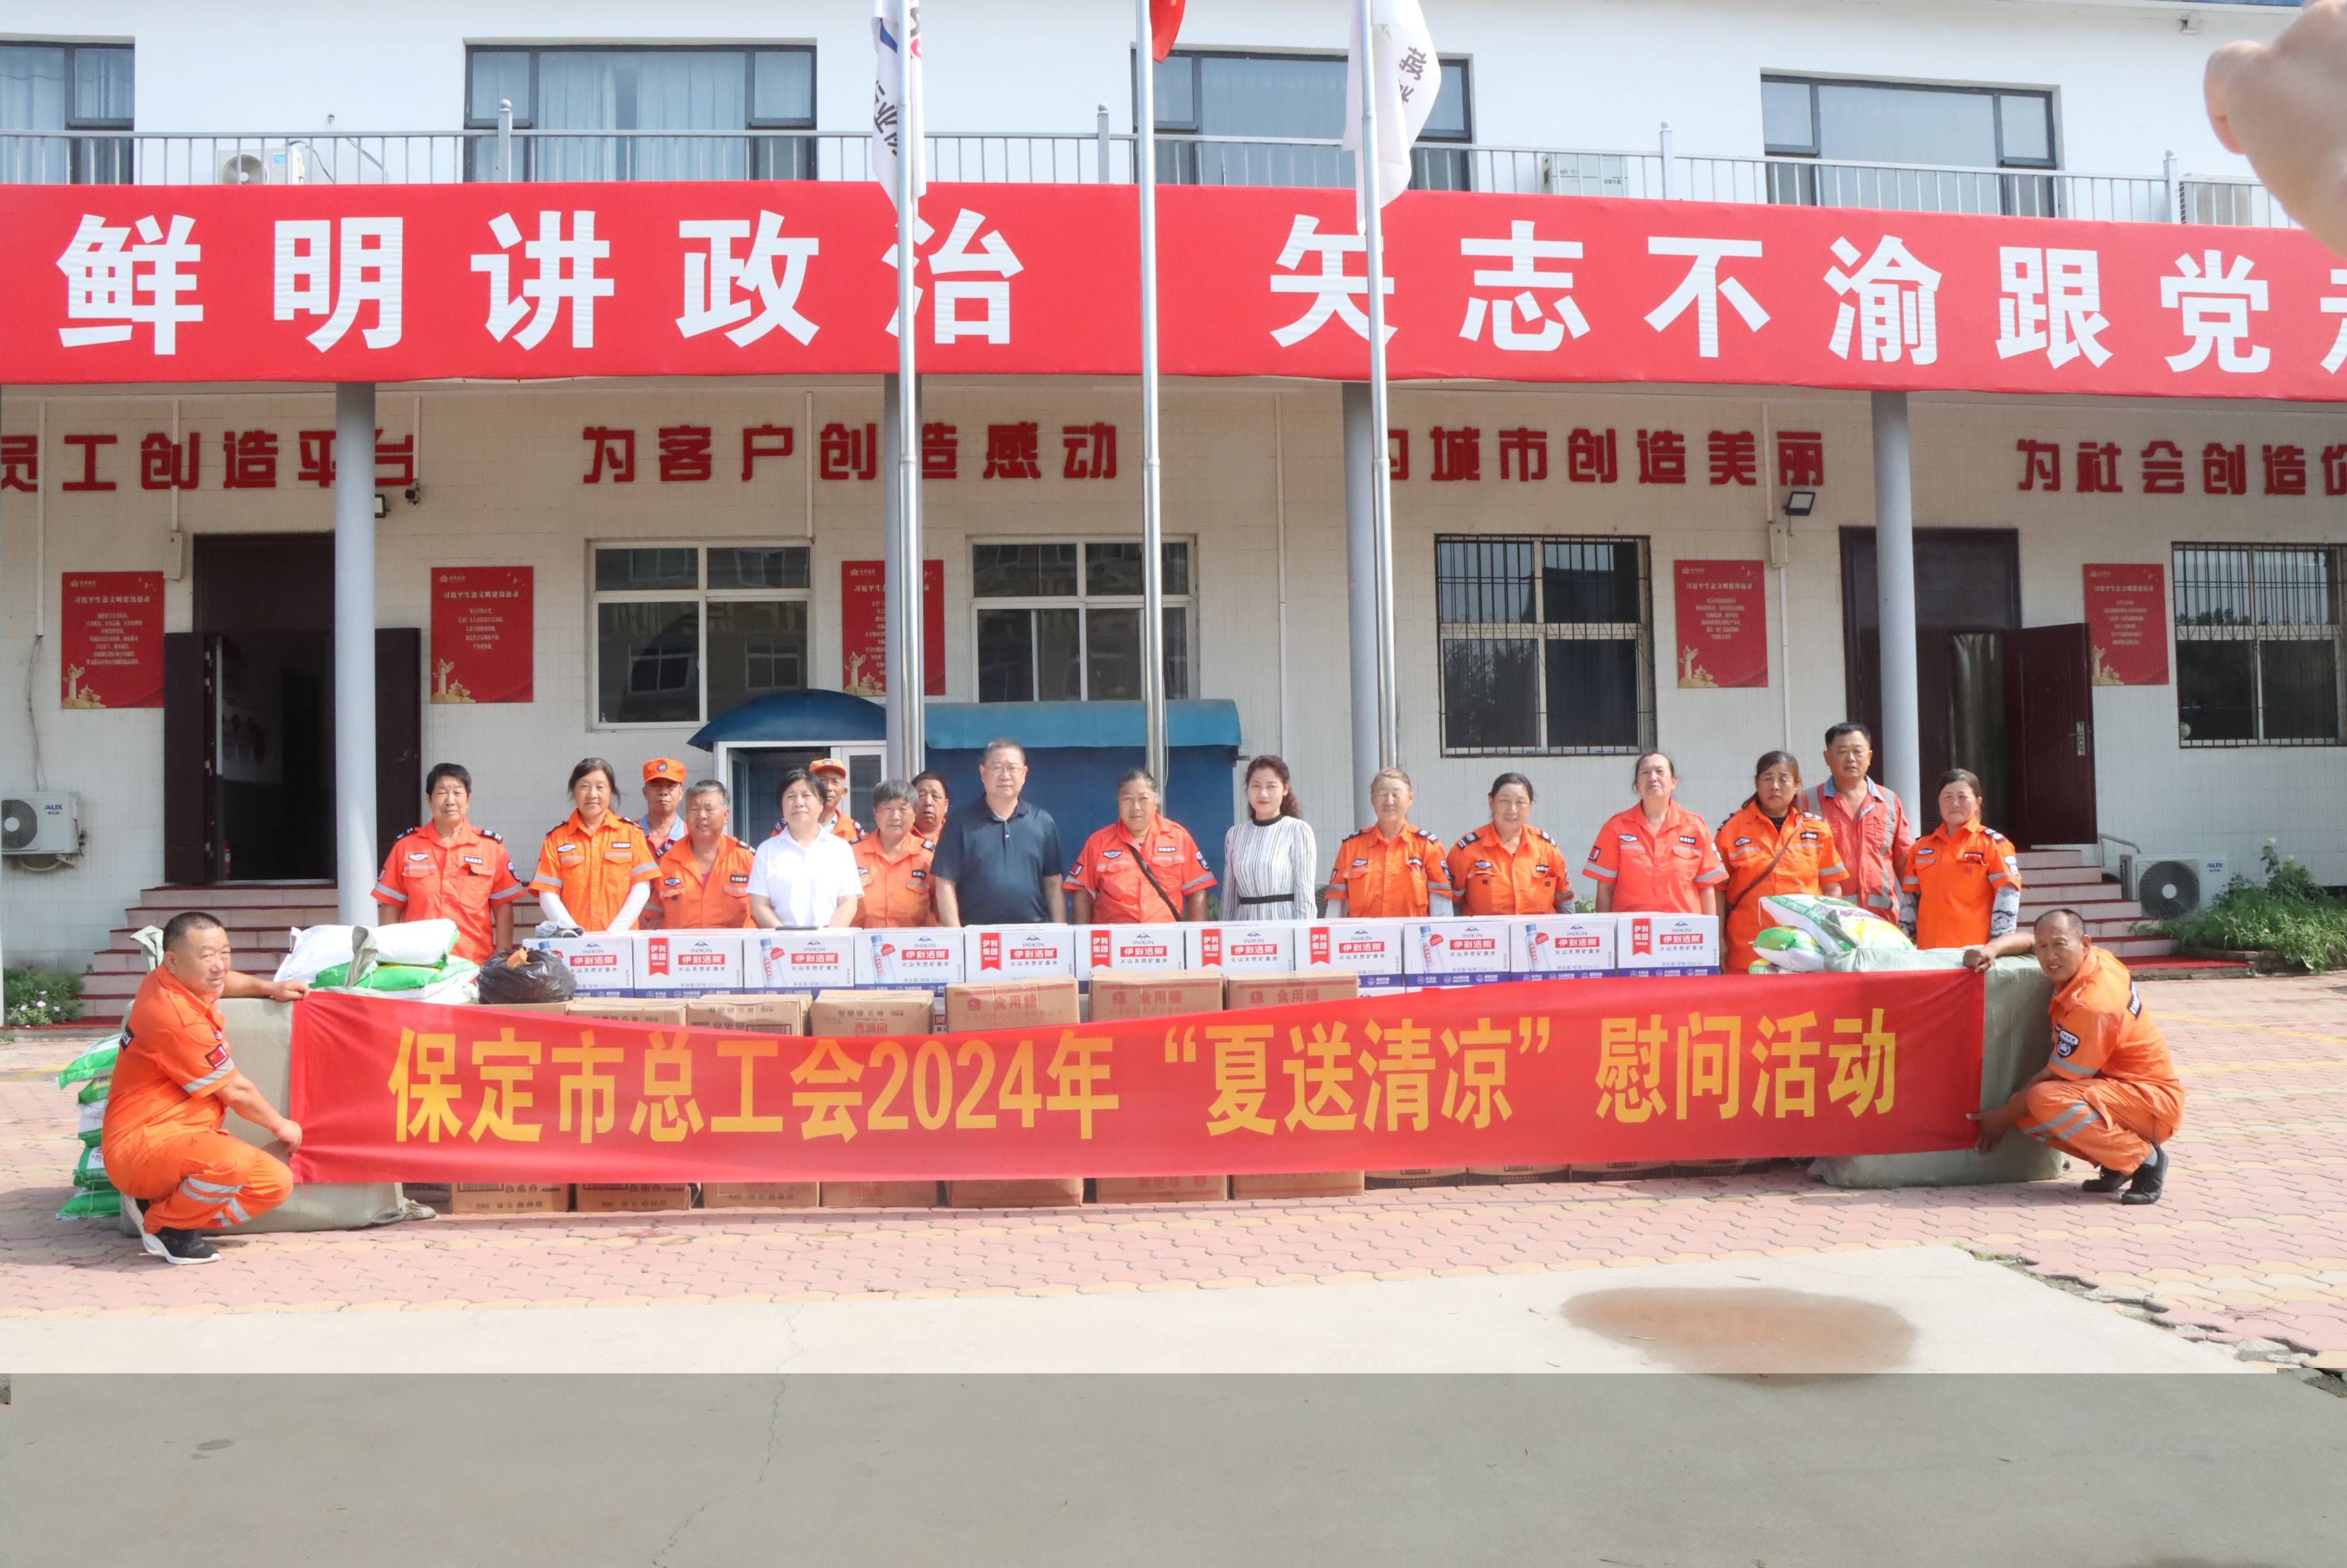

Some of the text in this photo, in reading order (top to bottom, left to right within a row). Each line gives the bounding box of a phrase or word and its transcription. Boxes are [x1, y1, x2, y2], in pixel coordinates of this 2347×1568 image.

[57, 209, 2347, 375] 鲜明讲政治 矢志不渝跟党
[583, 420, 1117, 484] 为客户创造感动
[387, 1007, 1897, 1144] 保定市总工会2024年 “夏送清凉” 慰问活动
